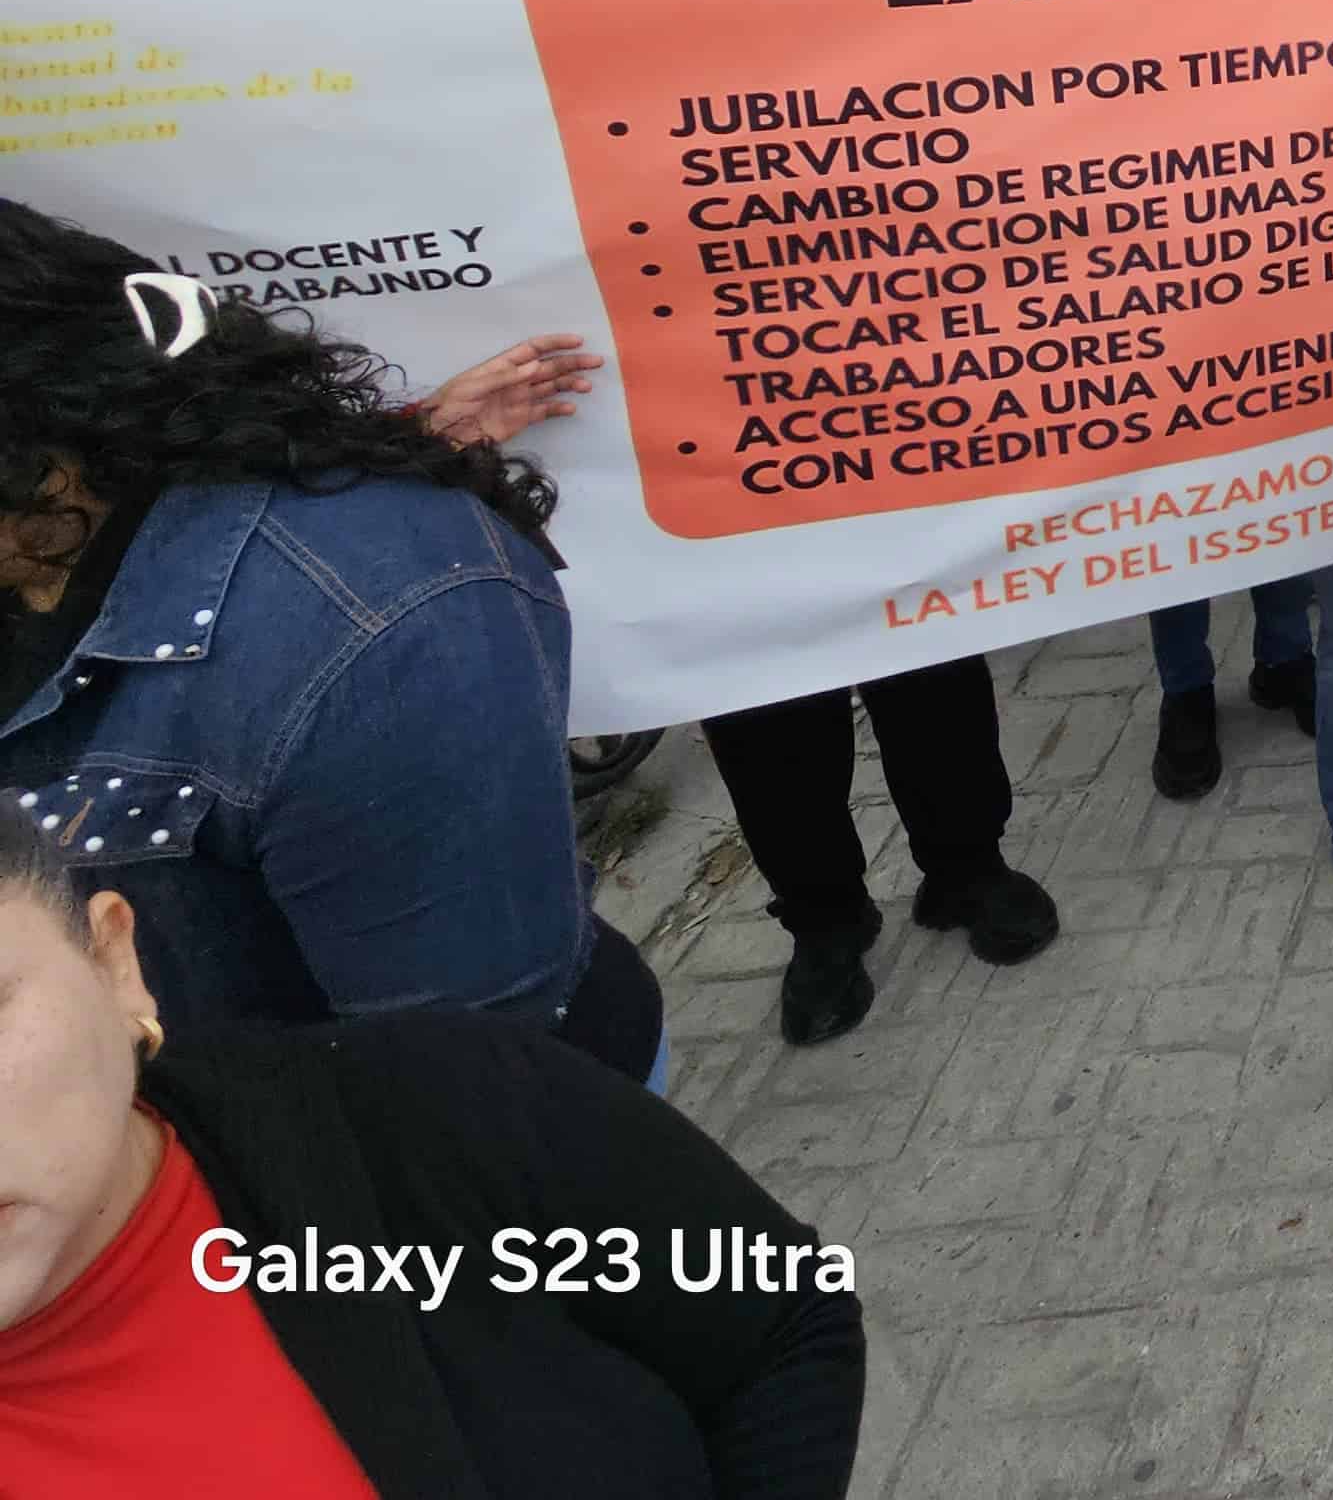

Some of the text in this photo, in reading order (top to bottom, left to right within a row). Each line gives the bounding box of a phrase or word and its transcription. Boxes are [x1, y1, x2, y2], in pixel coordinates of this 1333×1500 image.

[670, 70, 1034, 137] JUBILACION
[1052, 59, 1167, 104] POR
[681, 127, 970, 187] SERVICIO
[688, 179, 940, 232] CAMBIO
[956, 168, 1025, 209] DE
[1042, 136, 1275, 199] REGIMEN
[208, 232, 437, 277] DOCENTE
[451, 226, 484, 253] Y
[698, 171, 1326, 274] ELIMINACION DE UMAS
[713, 262, 987, 317] SERVICIO
[1003, 250, 1069, 288] DE
[1086, 230, 1251, 280] SALUD
[715, 312, 928, 362] TOCAR
[941, 303, 1000, 339] EL
[1017, 272, 1243, 330] SALARIO
[1258, 257, 1310, 295] SE
[723, 326, 1166, 406] TRABAJADORES
[734, 395, 972, 453] ACCESO
[988, 388, 1029, 423] A
[1040, 370, 1158, 414] UNA
[741, 448, 875, 494] CON
[890, 412, 1151, 476] CRÉDITOS
[883, 588, 958, 628] LA
[972, 561, 1066, 611] LEY
[1085, 542, 1172, 588] DEL
